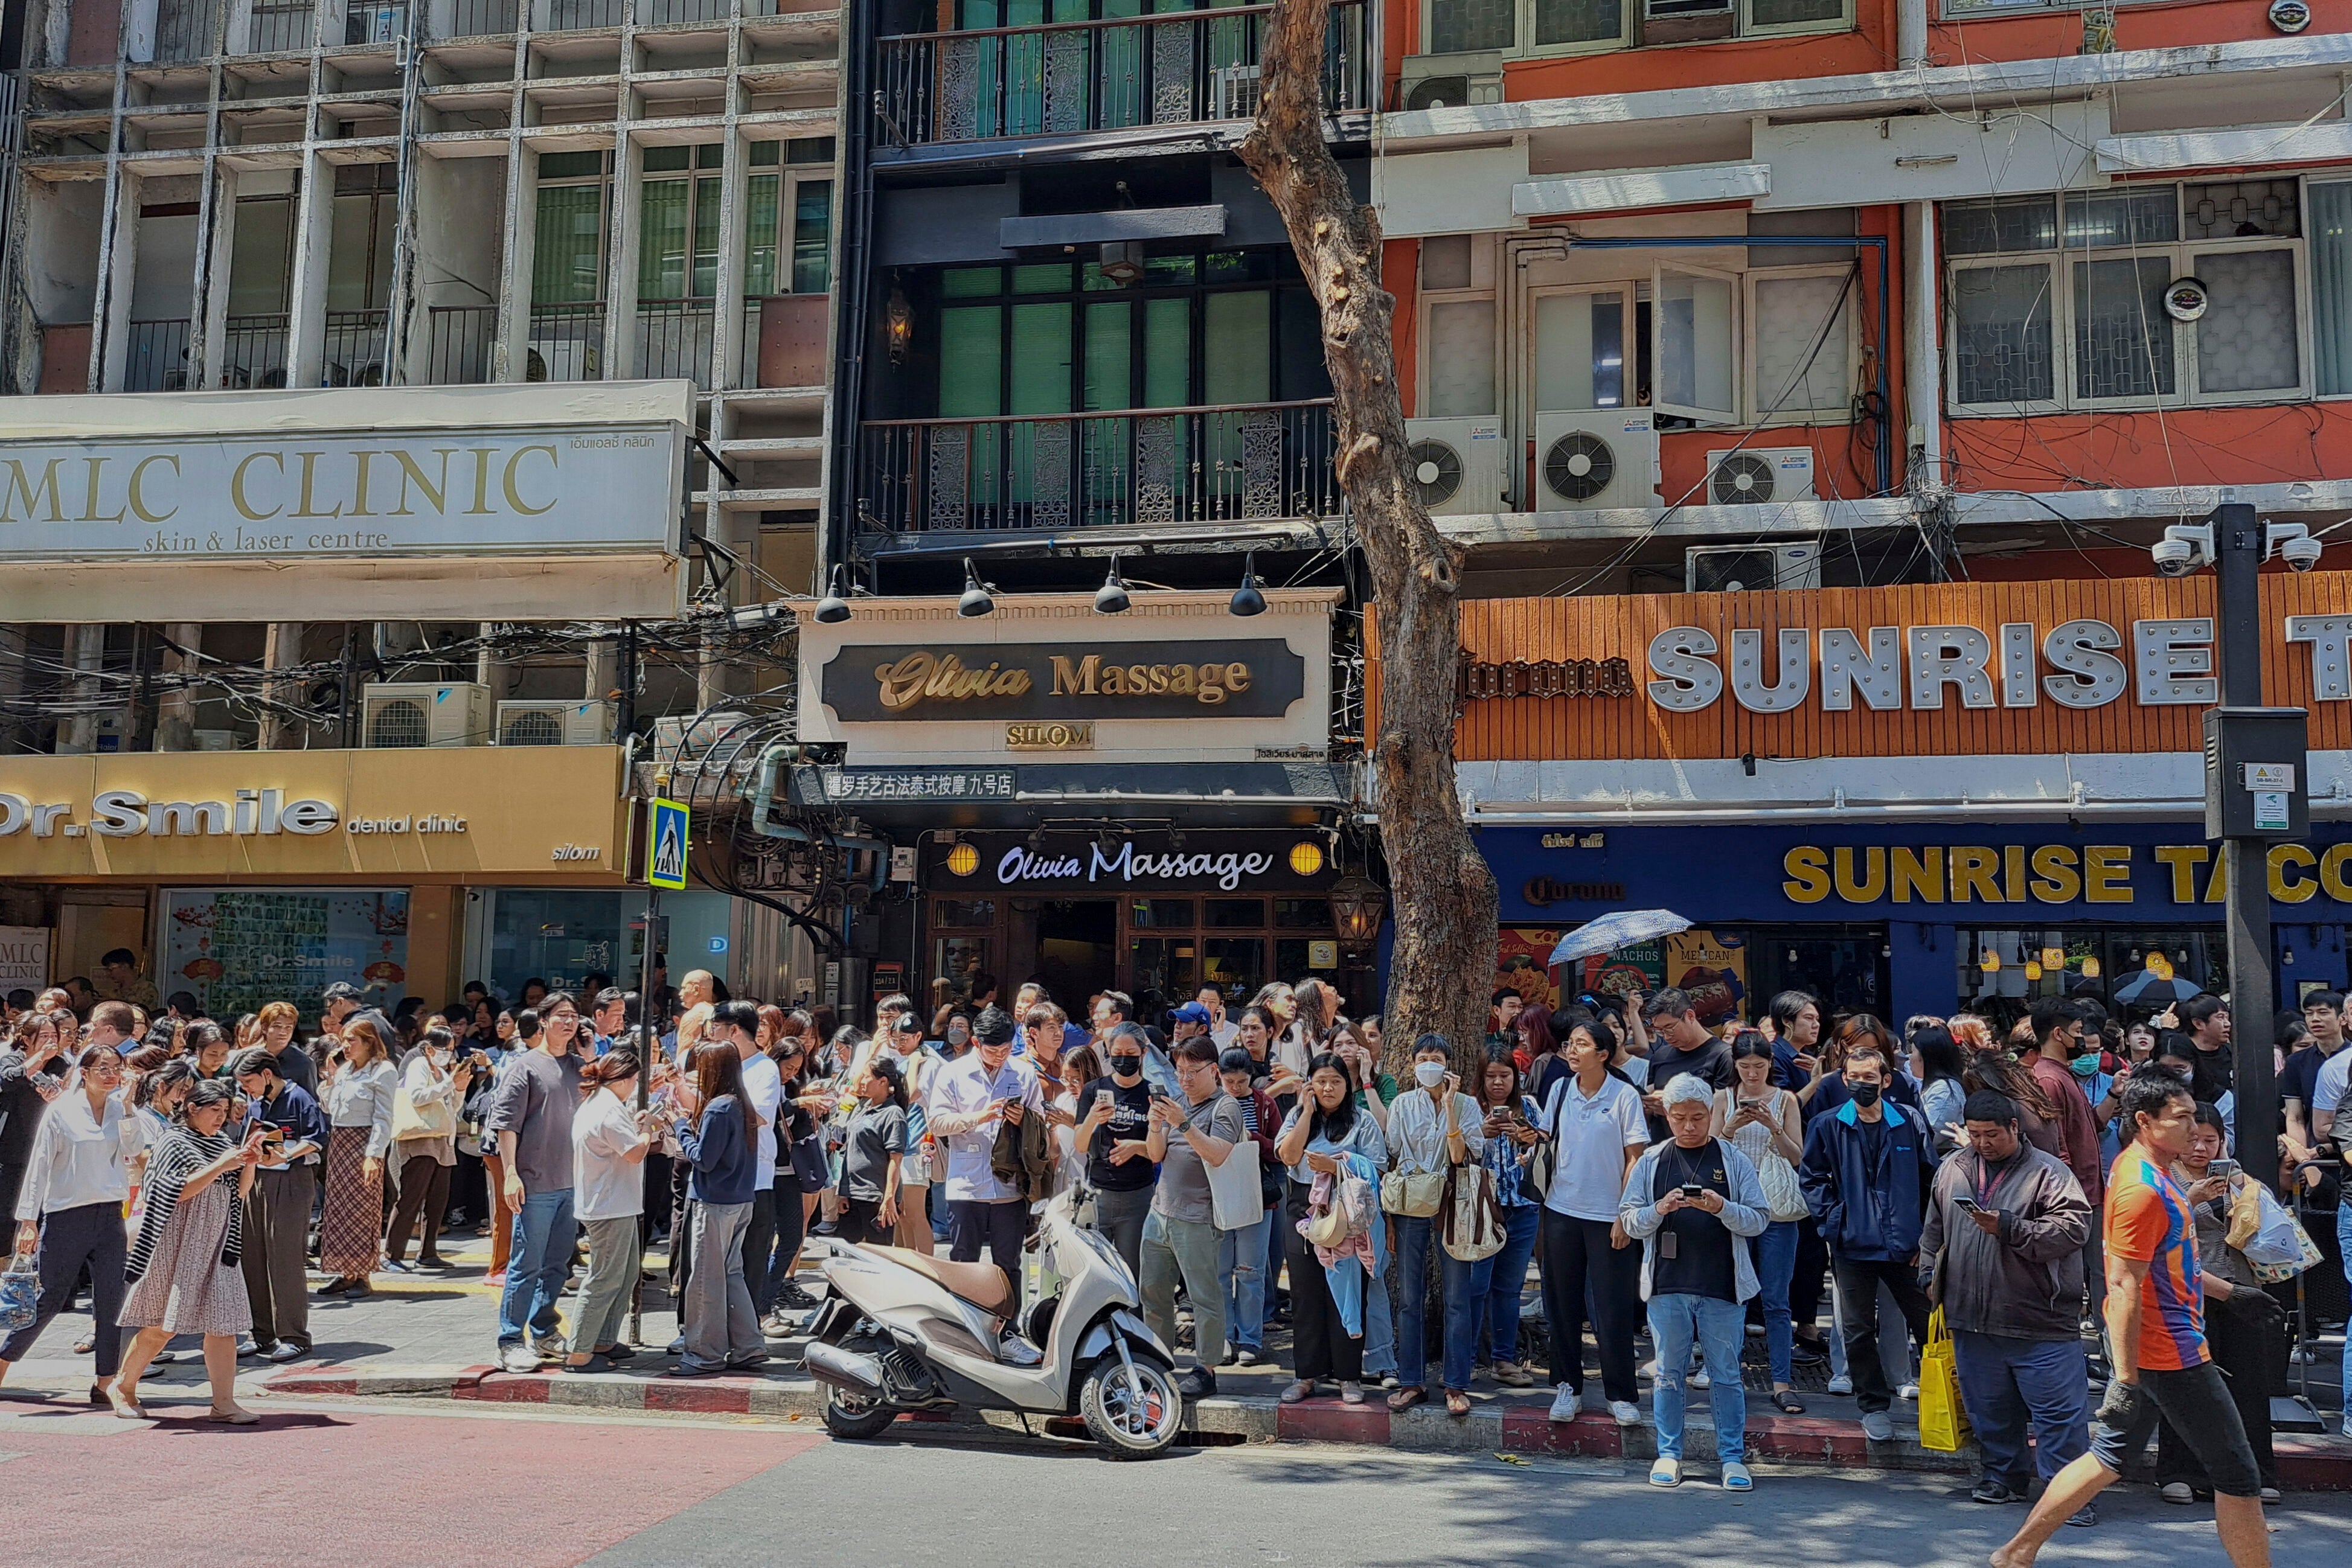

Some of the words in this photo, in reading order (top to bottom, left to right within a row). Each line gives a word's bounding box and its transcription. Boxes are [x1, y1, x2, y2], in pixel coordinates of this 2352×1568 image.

[624, 435, 655, 447] คลินิก
[0, 454, 181, 524] MLC
[231, 444, 559, 520] CLINIC
[144, 530, 196, 552] skin
[205, 530, 225, 551] &
[234, 527, 294, 551] laser
[308, 530, 388, 550] centre
[1647, 617, 2219, 714] SUNRISE
[874, 651, 1030, 708] Olivia
[1048, 654, 1250, 704] Massage
[1006, 724, 1091, 747] SILOM
[827, 774, 966, 797] 暹罗手艺古法泰式按摩
[969, 774, 1011, 796] 九号店
[346, 814, 412, 834] dental
[415, 813, 467, 833] clinic
[551, 842, 600, 861] silom
[997, 846, 1082, 885] Olivia
[1088, 841, 1274, 891] Massage
[1783, 845, 2134, 904] SUNRISE
[0, 943, 43, 964] MLC
[1612, 950, 1659, 961] NACHOS
